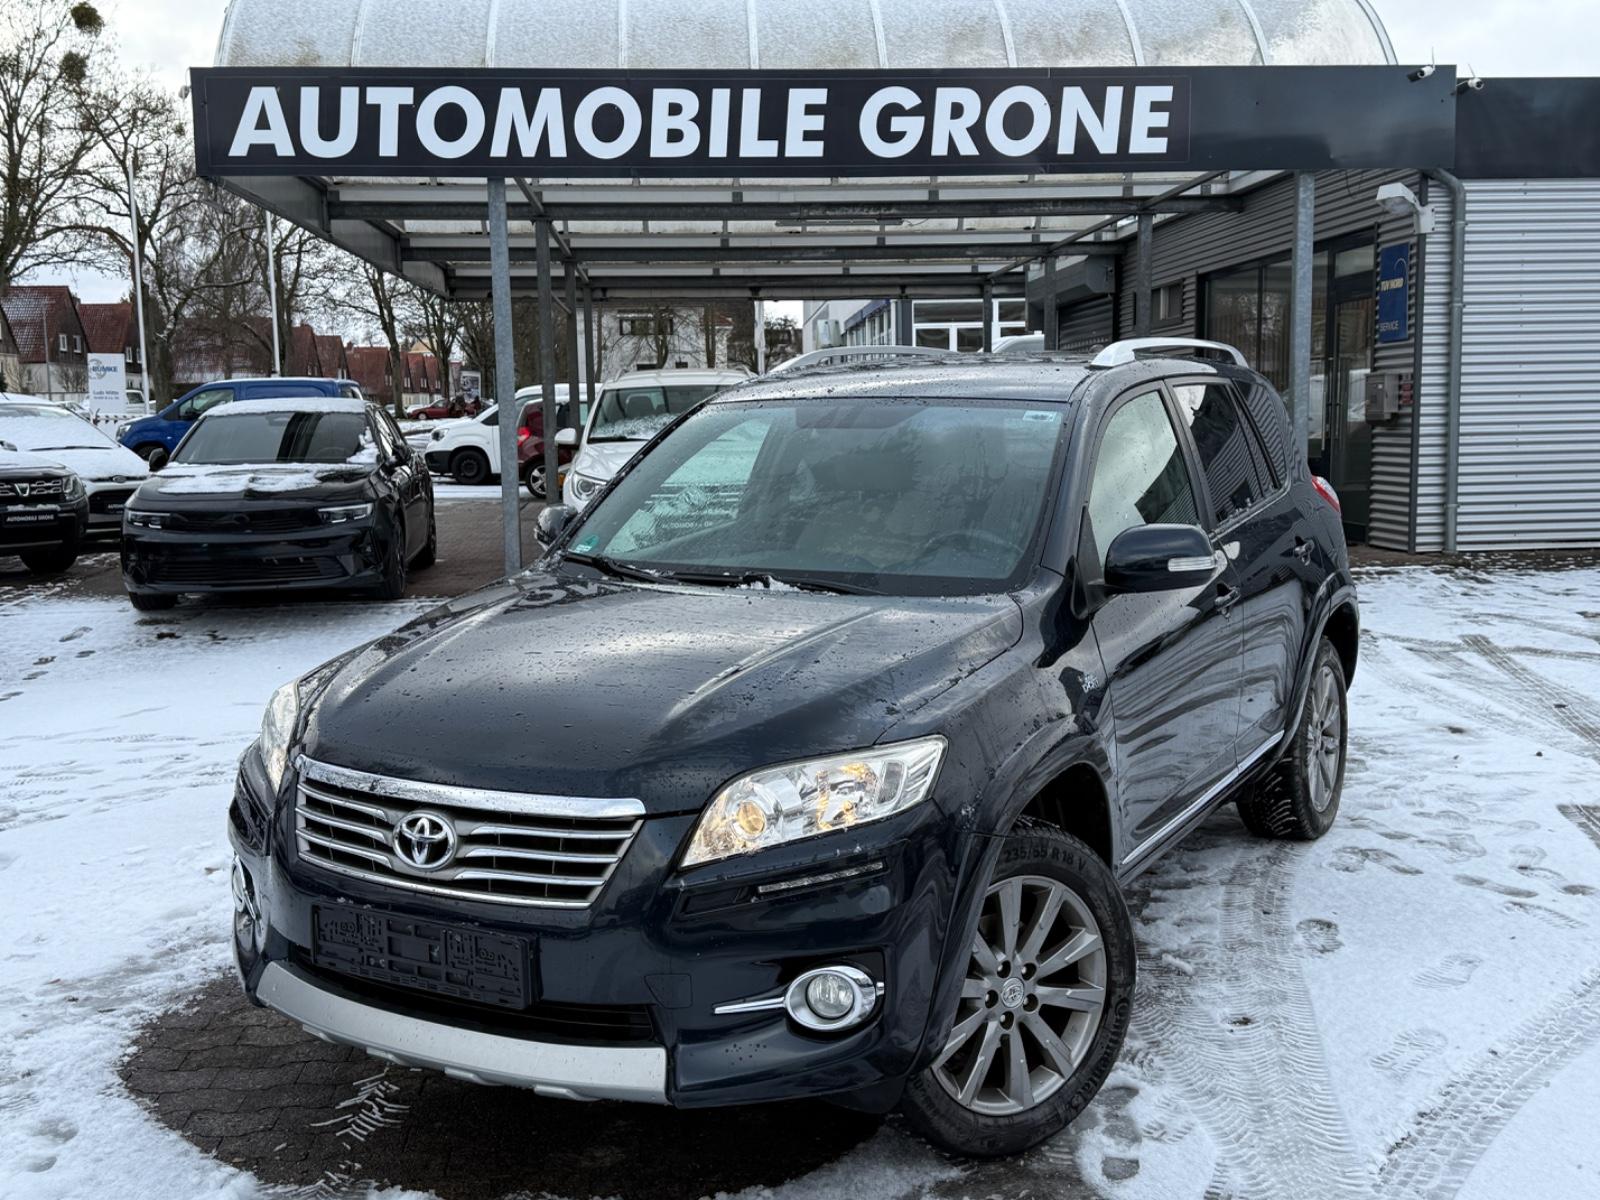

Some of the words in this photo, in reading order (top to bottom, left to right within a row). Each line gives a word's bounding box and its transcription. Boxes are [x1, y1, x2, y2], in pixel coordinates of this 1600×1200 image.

[228, 85, 828, 159] AUTOMOBILE
[859, 85, 1174, 158] GRONE
[6, 514, 37, 522] AUTOMOBILE
